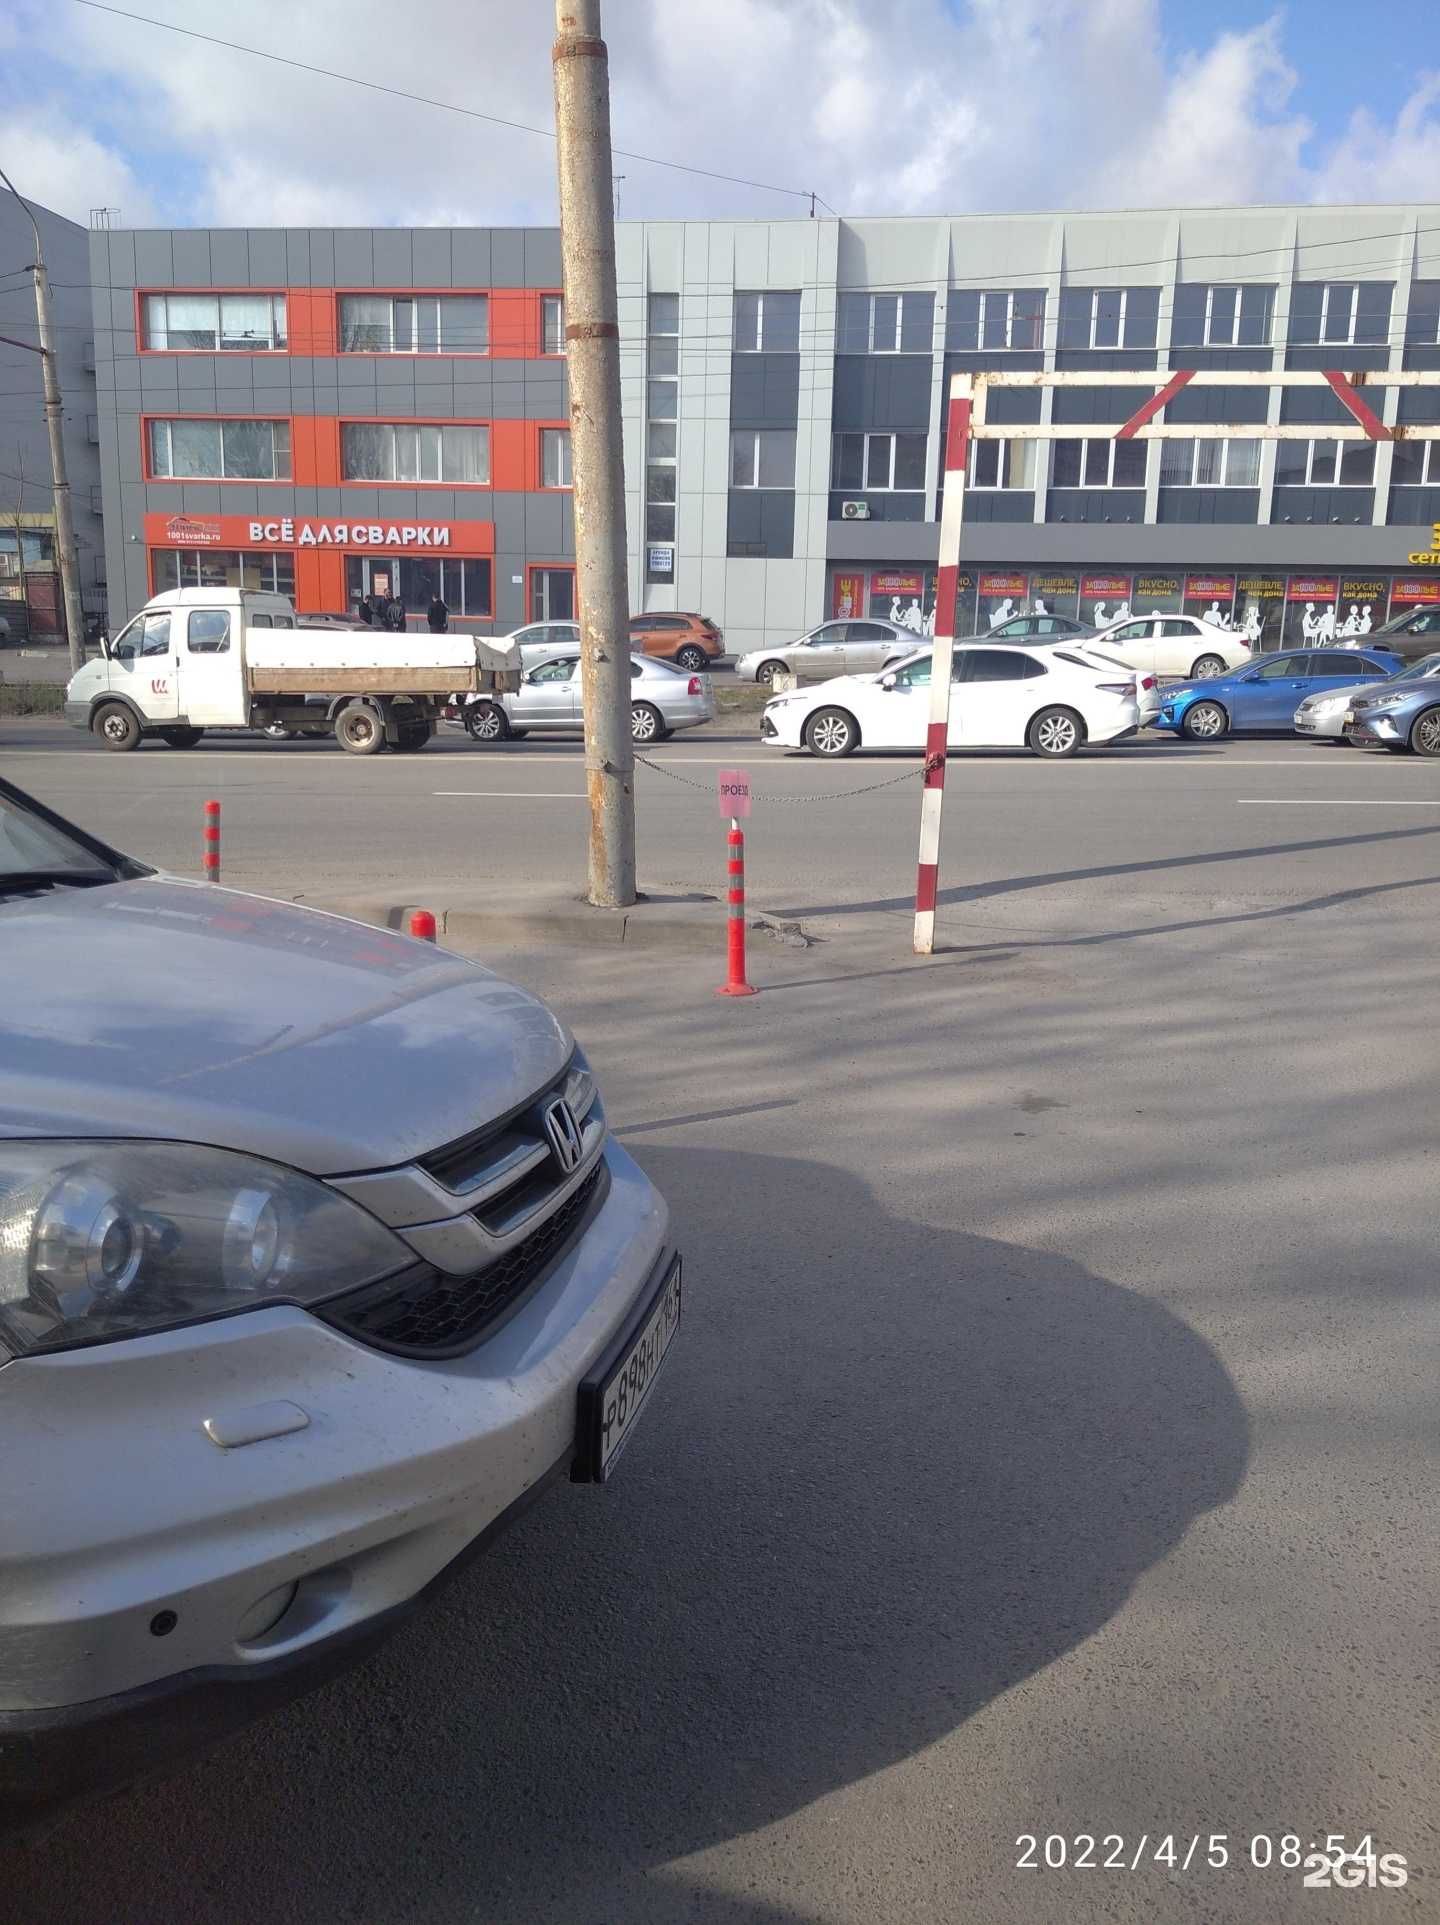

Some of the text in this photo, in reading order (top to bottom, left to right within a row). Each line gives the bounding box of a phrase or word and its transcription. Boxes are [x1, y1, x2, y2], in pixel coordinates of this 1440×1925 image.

[249, 518, 450, 546] ВСЁ ДЛЯ СВАРКИ
